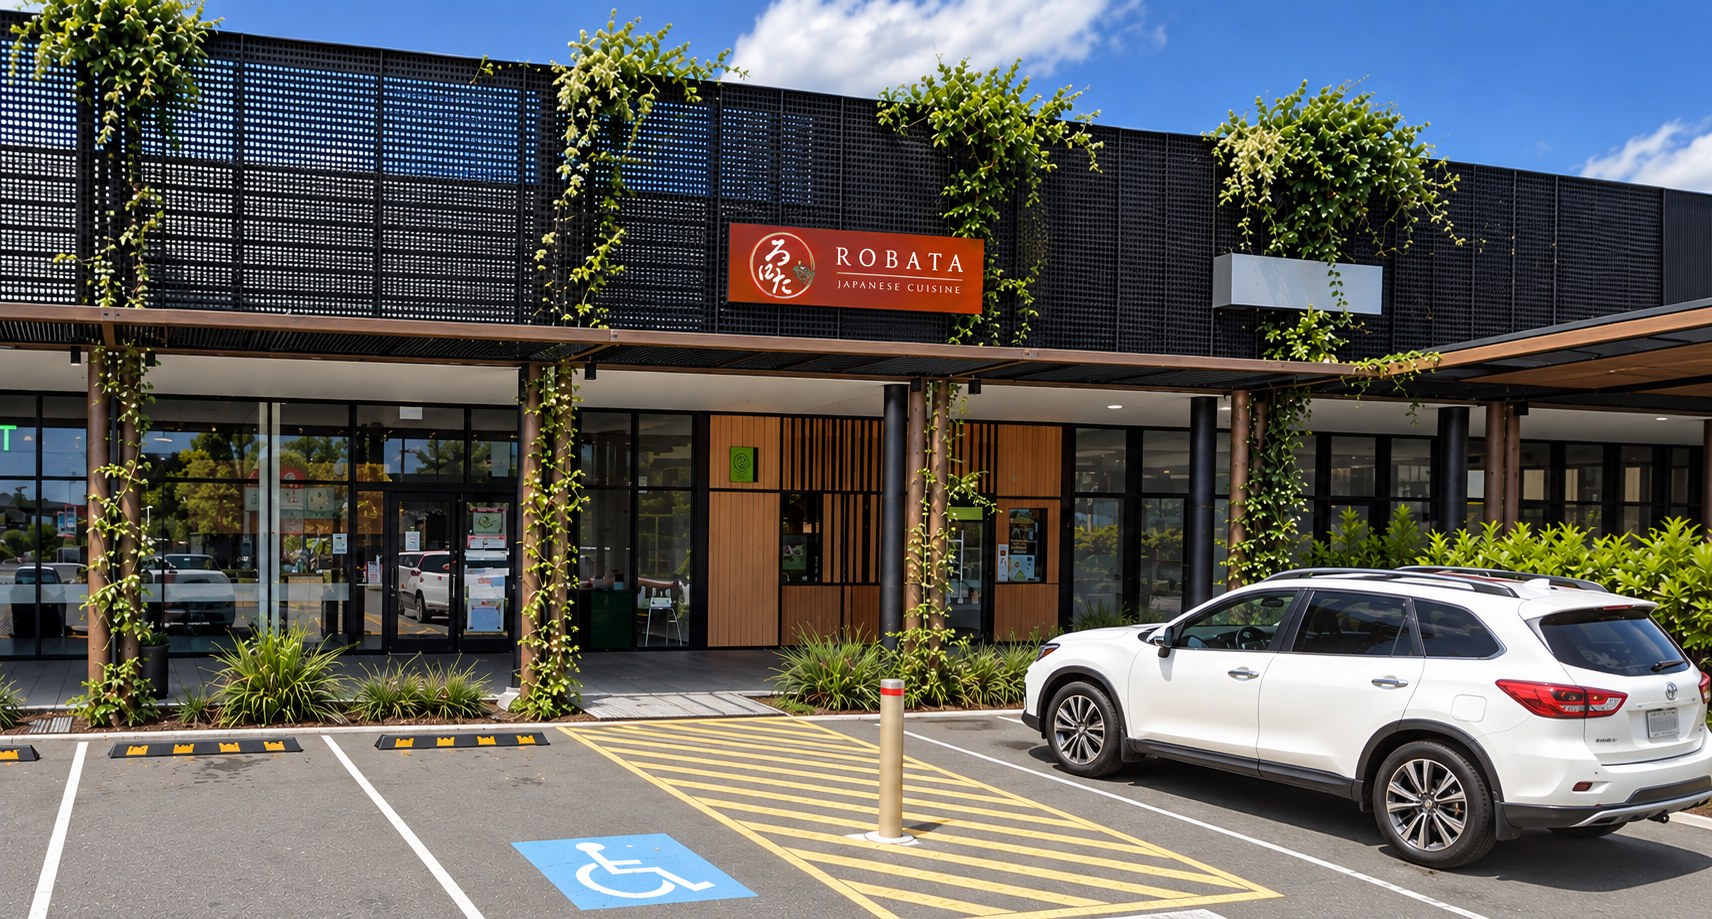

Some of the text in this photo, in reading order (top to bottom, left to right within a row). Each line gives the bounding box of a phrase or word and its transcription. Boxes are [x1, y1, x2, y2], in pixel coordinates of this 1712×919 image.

[836, 247, 964, 273] ROBATA
[837, 280, 961, 294] JAPANESE CUISINE
